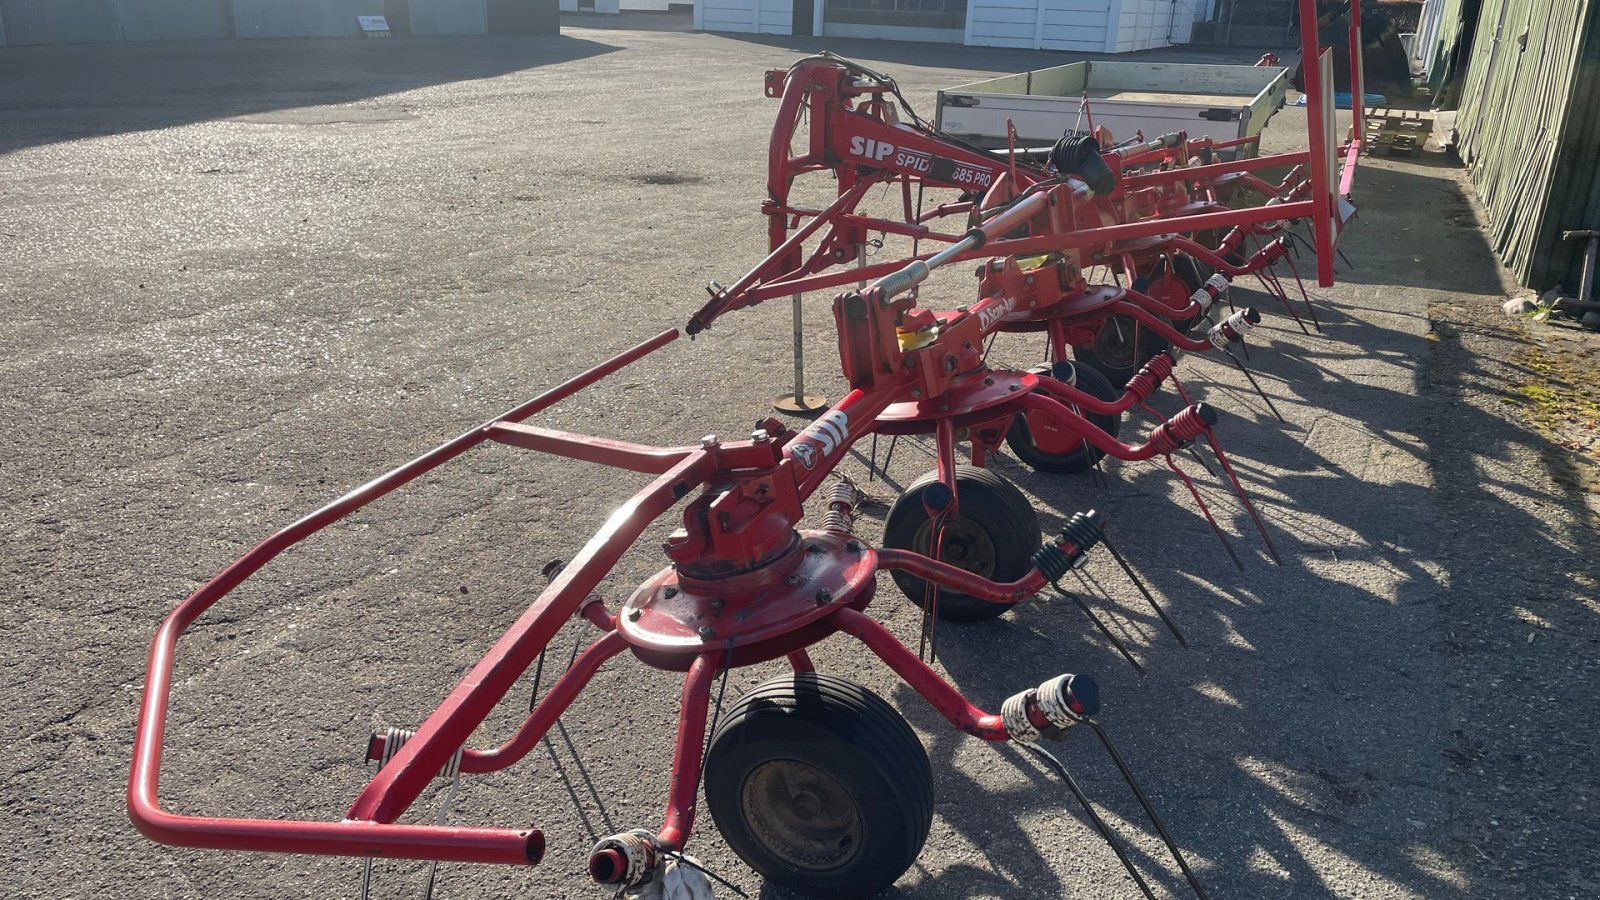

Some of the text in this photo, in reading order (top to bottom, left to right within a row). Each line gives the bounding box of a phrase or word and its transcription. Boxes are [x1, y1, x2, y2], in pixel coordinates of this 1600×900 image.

[850, 135, 894, 161] SIP
[896, 153, 930, 171] SPID
[974, 173, 990, 187] PRO
[803, 410, 849, 457] SIP
